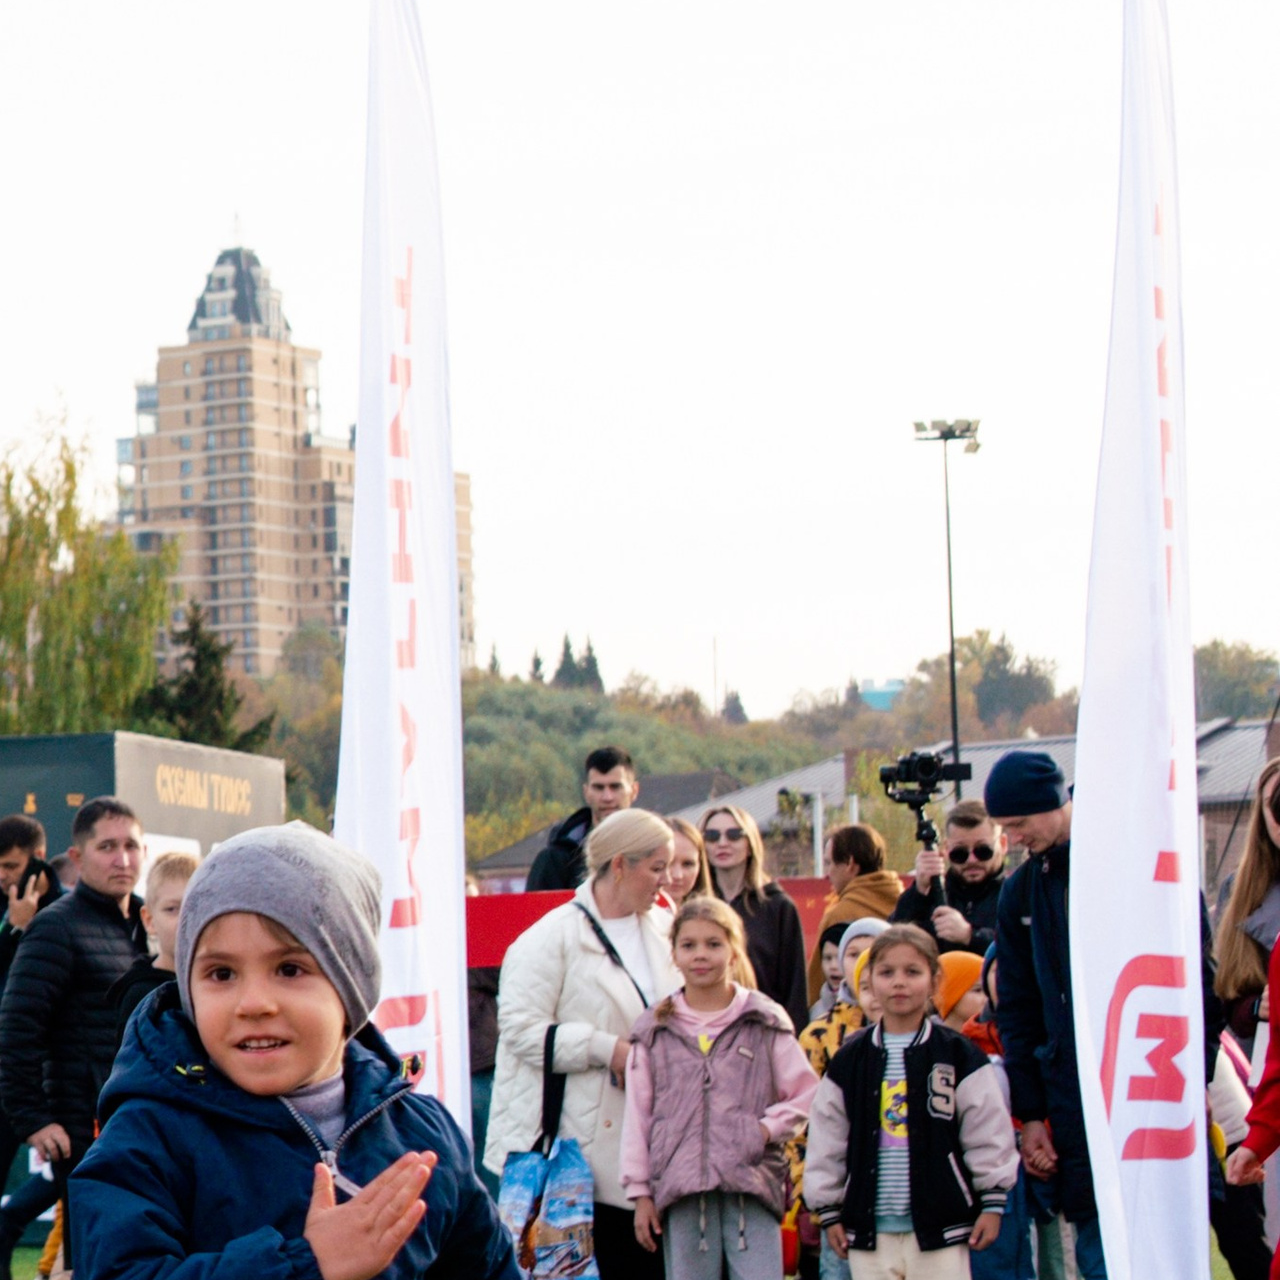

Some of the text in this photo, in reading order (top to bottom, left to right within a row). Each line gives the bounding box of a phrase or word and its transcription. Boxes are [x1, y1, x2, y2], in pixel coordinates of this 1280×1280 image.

[156, 763, 253, 816] СХЕМЫ ТРАСС
[927, 1062, 956, 1121] S
